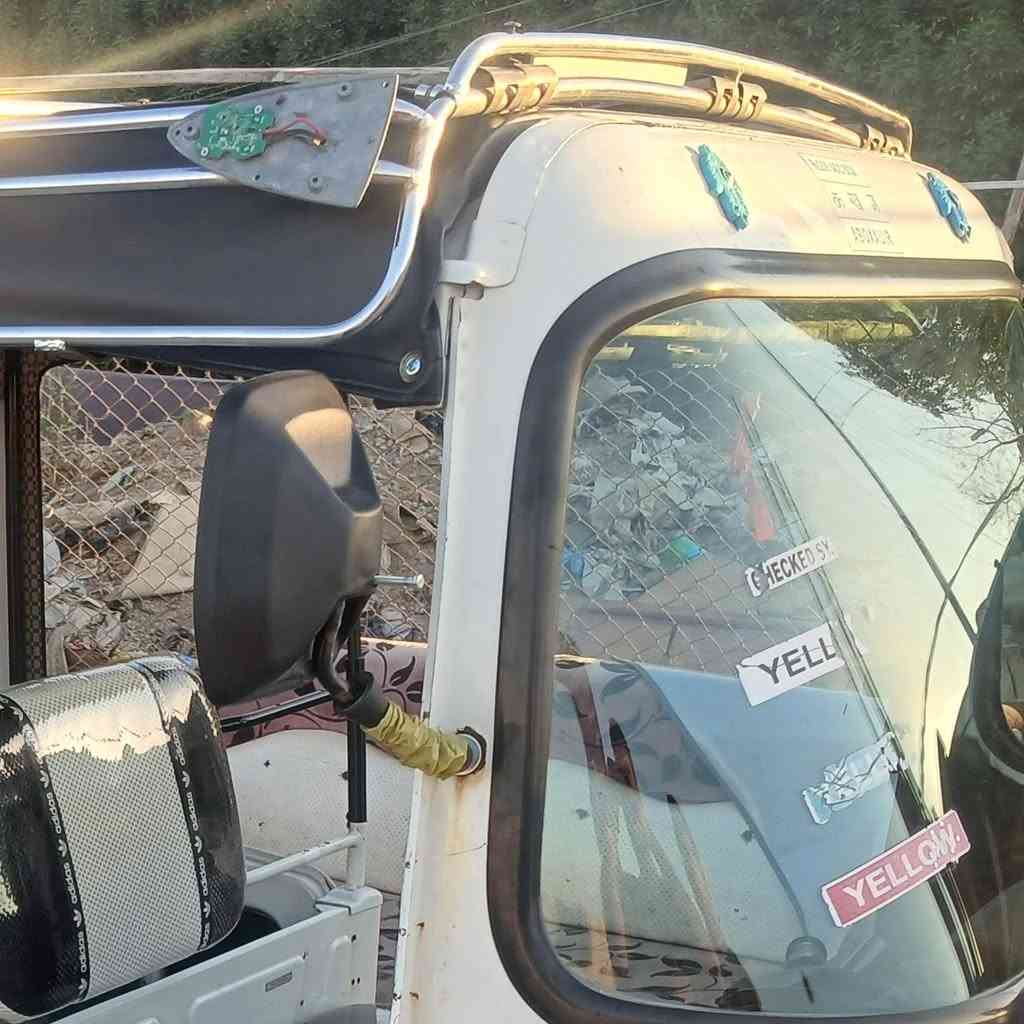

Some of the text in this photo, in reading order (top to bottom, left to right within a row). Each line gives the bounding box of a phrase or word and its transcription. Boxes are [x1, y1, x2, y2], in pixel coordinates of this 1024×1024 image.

[758, 637, 837, 684] YELL
[46, 792, 61, 834] adidas
[186, 791, 198, 831] adidas
[63, 862, 77, 904] adidas
[198, 856, 209, 896] adidas
[77, 930, 88, 973] adidas
